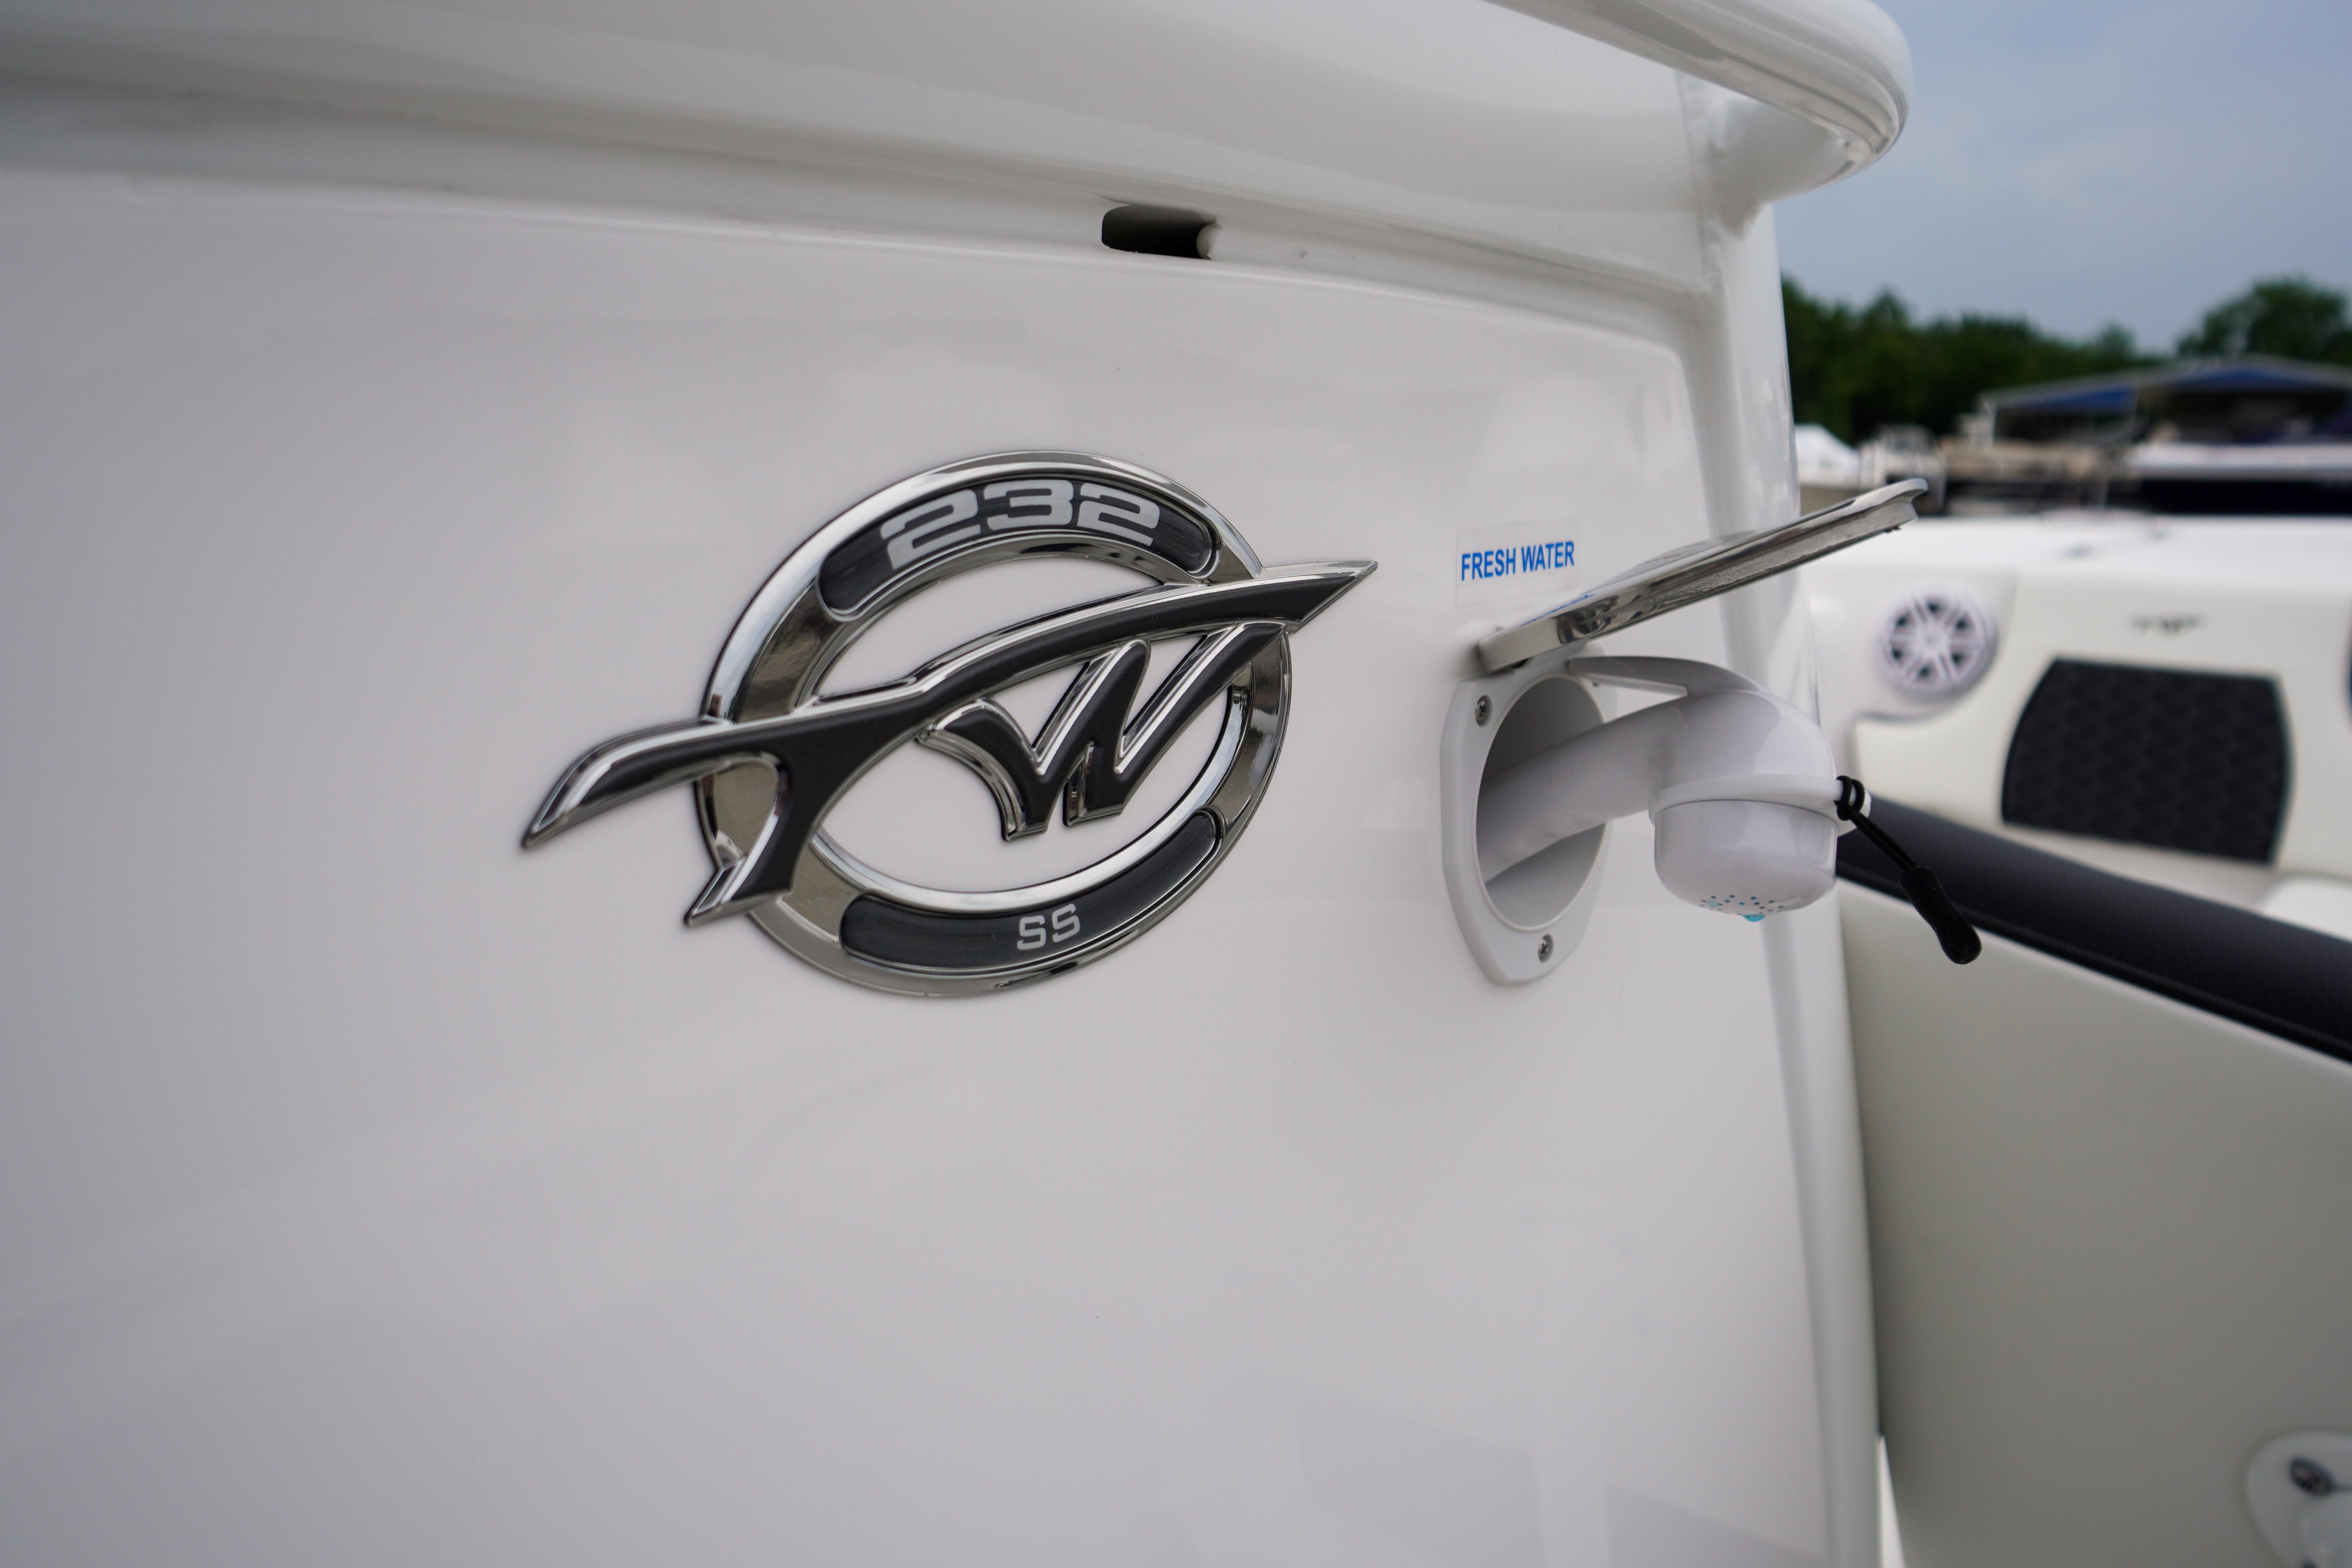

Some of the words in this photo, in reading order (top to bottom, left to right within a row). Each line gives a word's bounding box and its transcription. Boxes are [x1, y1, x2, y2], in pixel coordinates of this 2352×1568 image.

[880, 479, 1160, 570] 232
[1461, 547, 1516, 581] FRESH
[1521, 541, 1575, 573] WATER
[1017, 903, 1081, 950] SS
